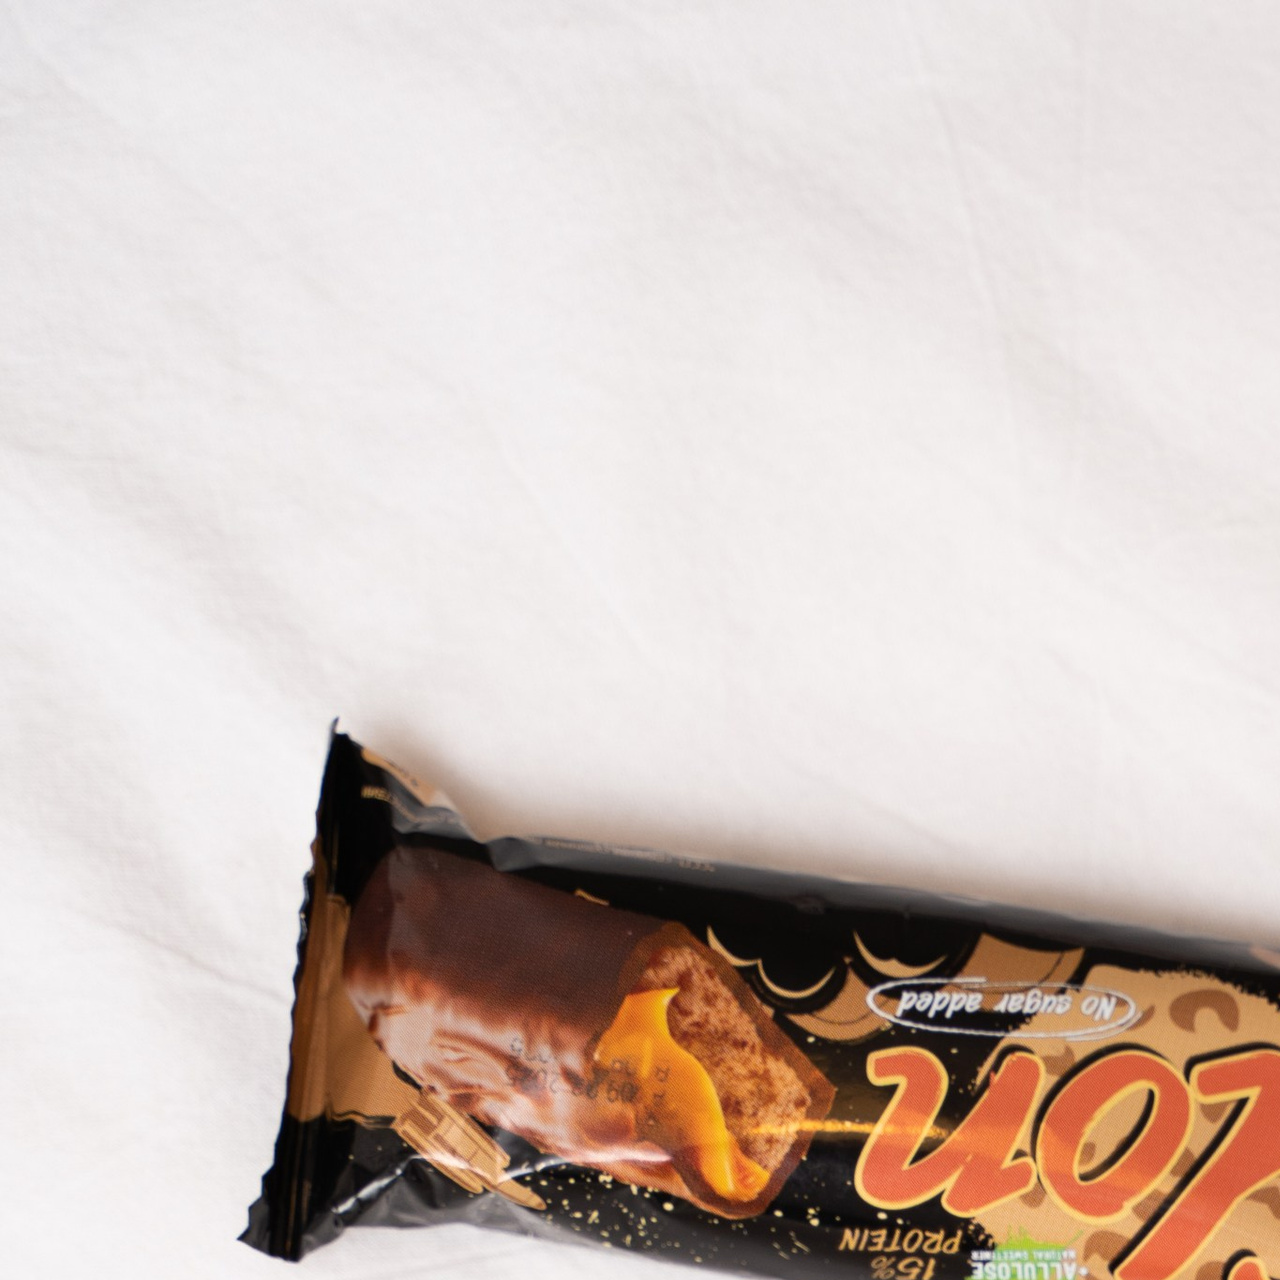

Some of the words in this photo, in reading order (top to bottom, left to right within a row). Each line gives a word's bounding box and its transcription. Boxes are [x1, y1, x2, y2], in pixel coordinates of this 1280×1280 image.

[896, 990, 983, 1018] added
[993, 988, 1071, 1016] sugar
[1079, 995, 1117, 1022] No
[838, 1227, 963, 1254] PROTEIN
